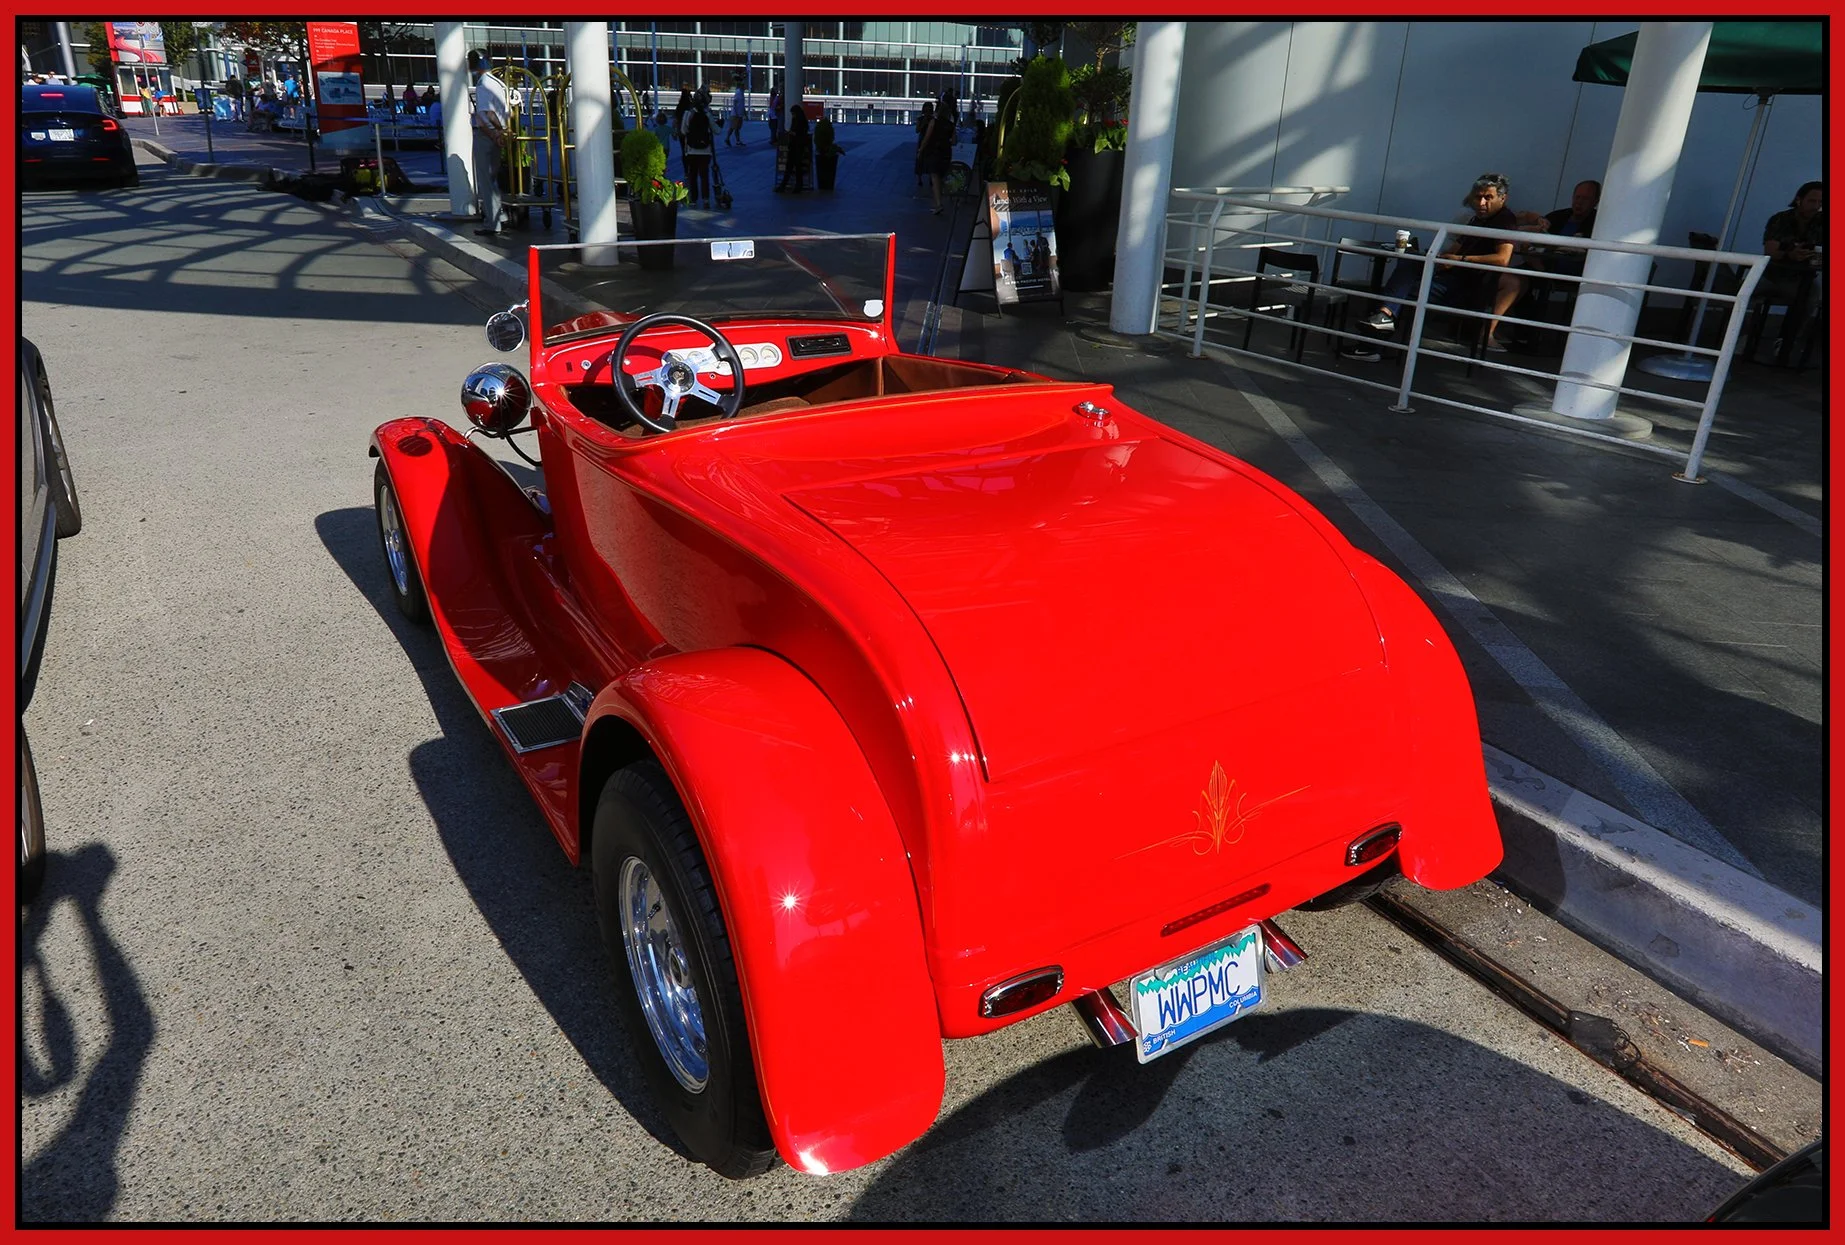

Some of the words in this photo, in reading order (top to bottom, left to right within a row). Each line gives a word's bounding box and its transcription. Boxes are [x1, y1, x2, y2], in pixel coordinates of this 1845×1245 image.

[1158, 960, 1240, 1030] WWPMC
[1229, 991, 1258, 1009] COLUMBIA
[1152, 1029, 1176, 1045] BRITISH
